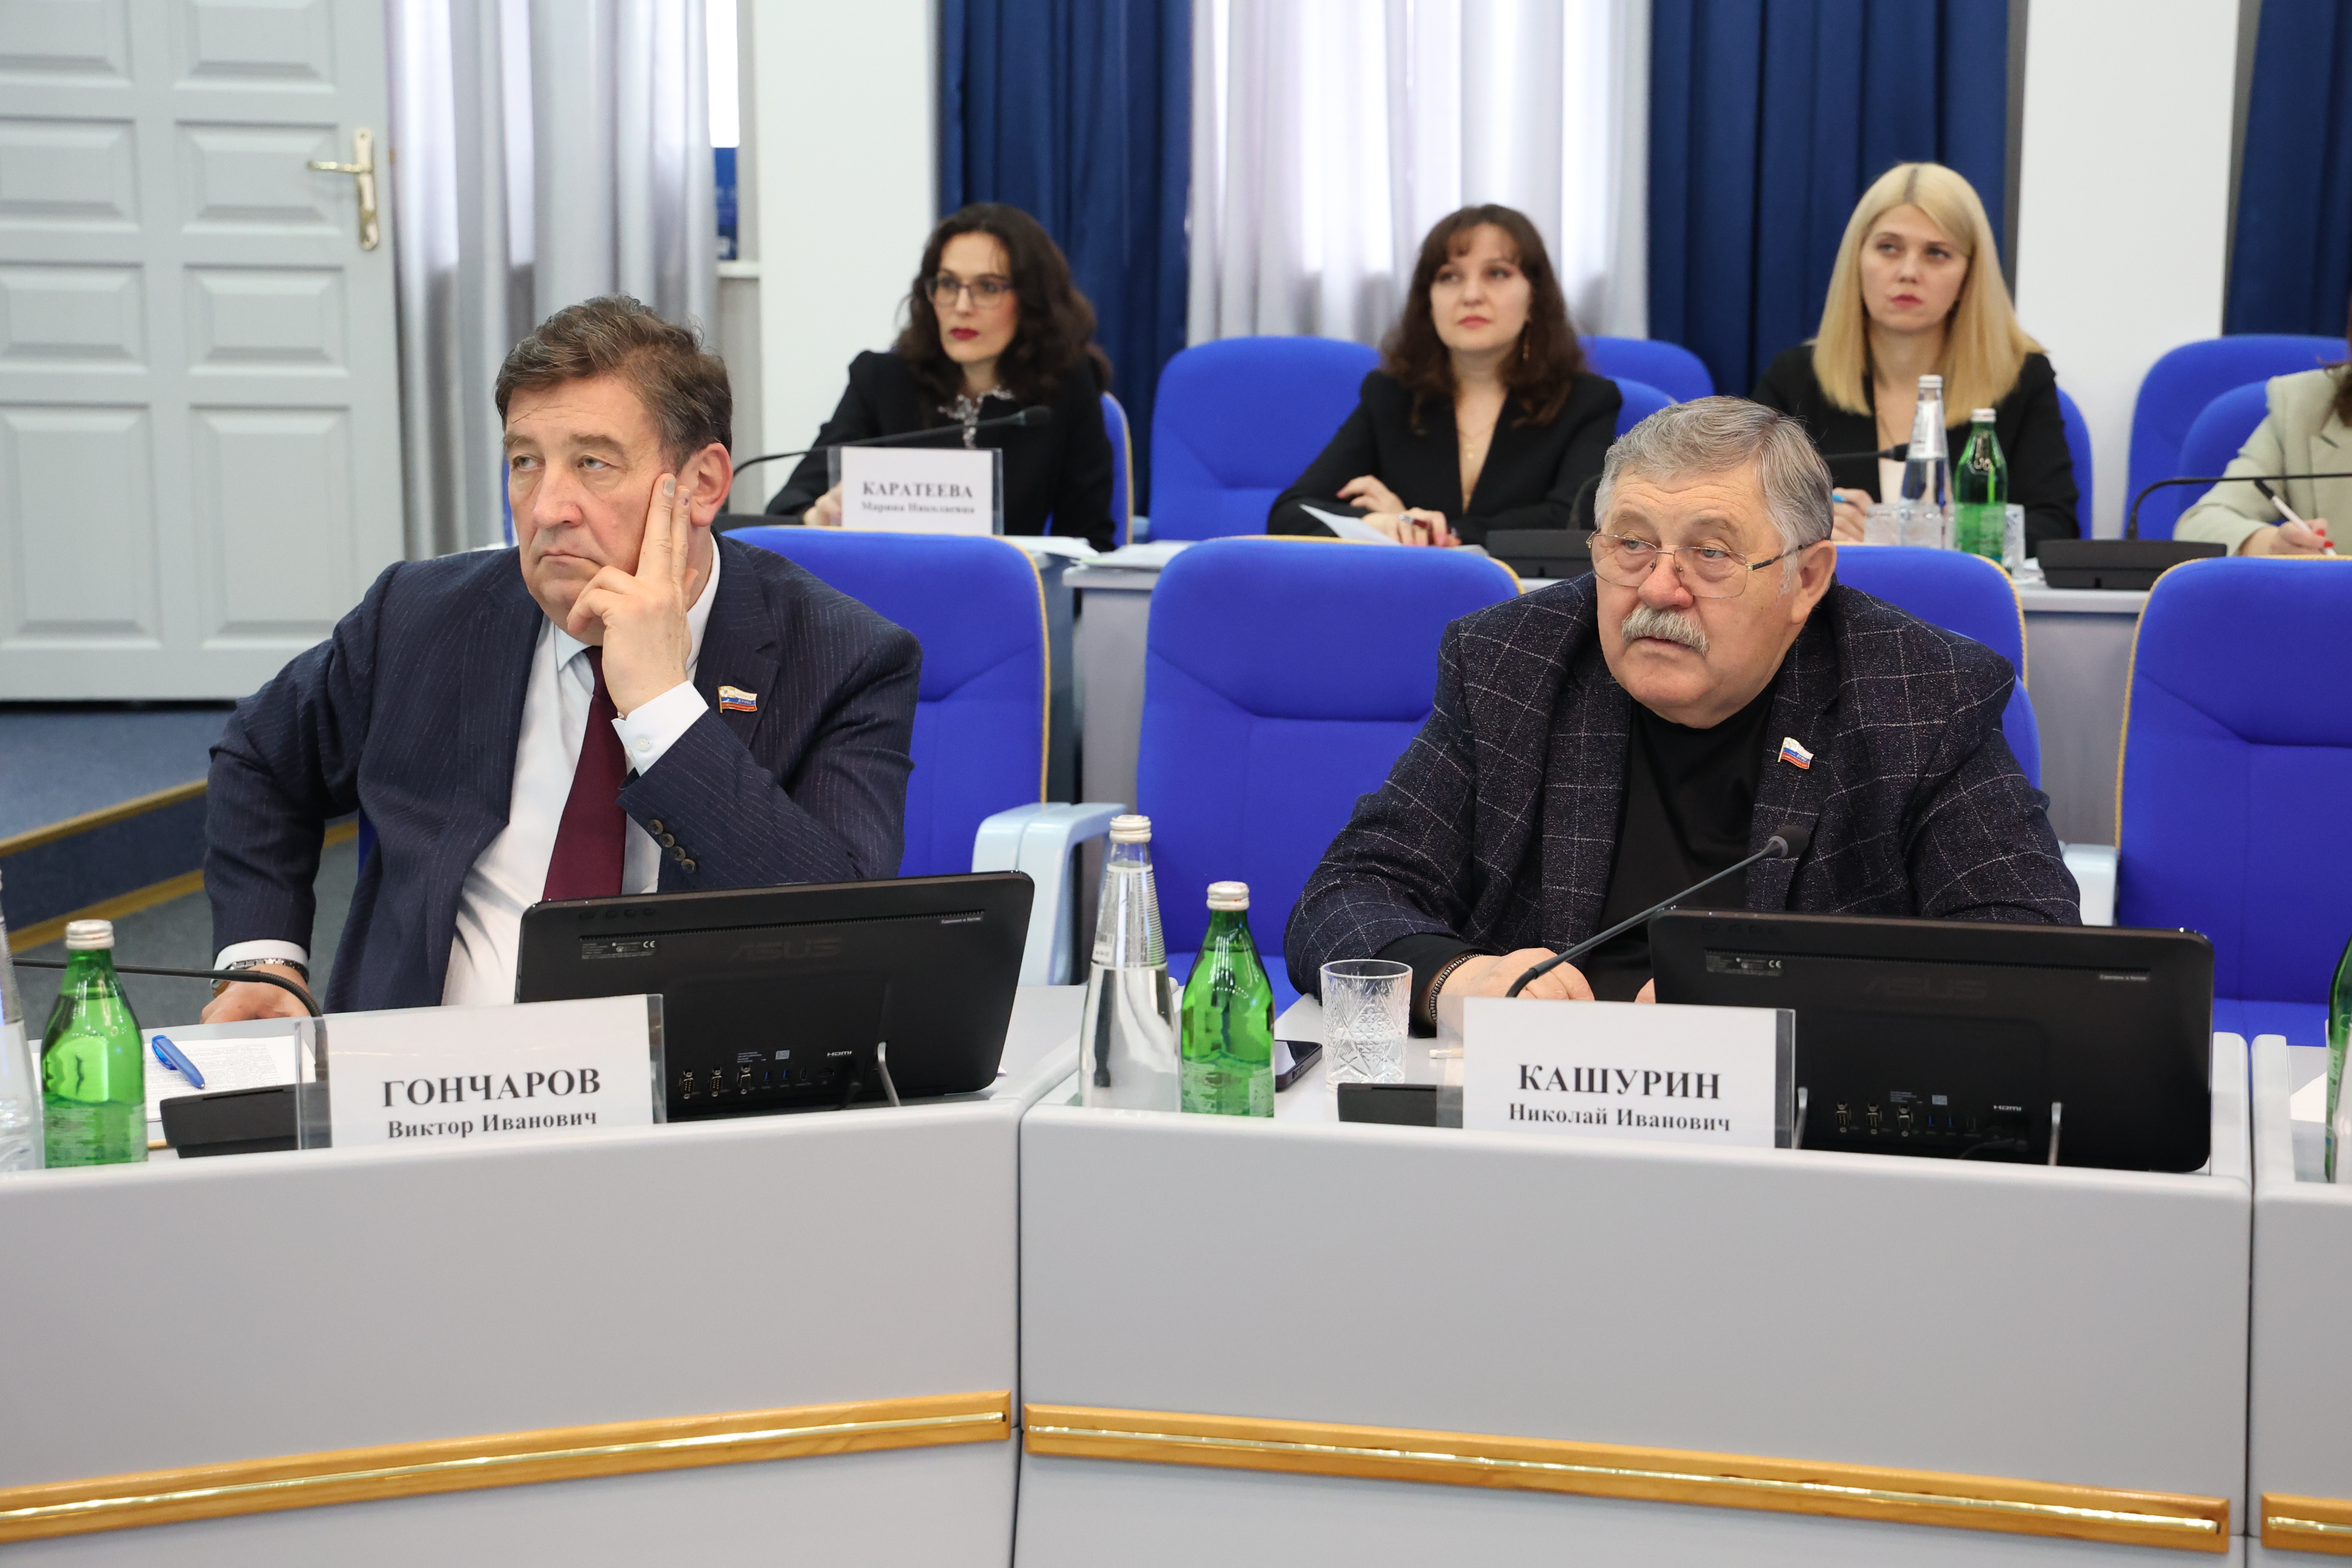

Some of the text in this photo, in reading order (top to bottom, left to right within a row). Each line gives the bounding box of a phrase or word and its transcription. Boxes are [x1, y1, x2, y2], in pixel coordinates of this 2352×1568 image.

[863, 481, 973, 497] КАРАТЕЕВА
[382, 1068, 601, 1107] ГОНЧАРОВ
[1518, 1064, 1721, 1099] КАШУРИН
[387, 1112, 597, 1138] Виктор Иванович
[1509, 1102, 1730, 1131] Николай Иванович
